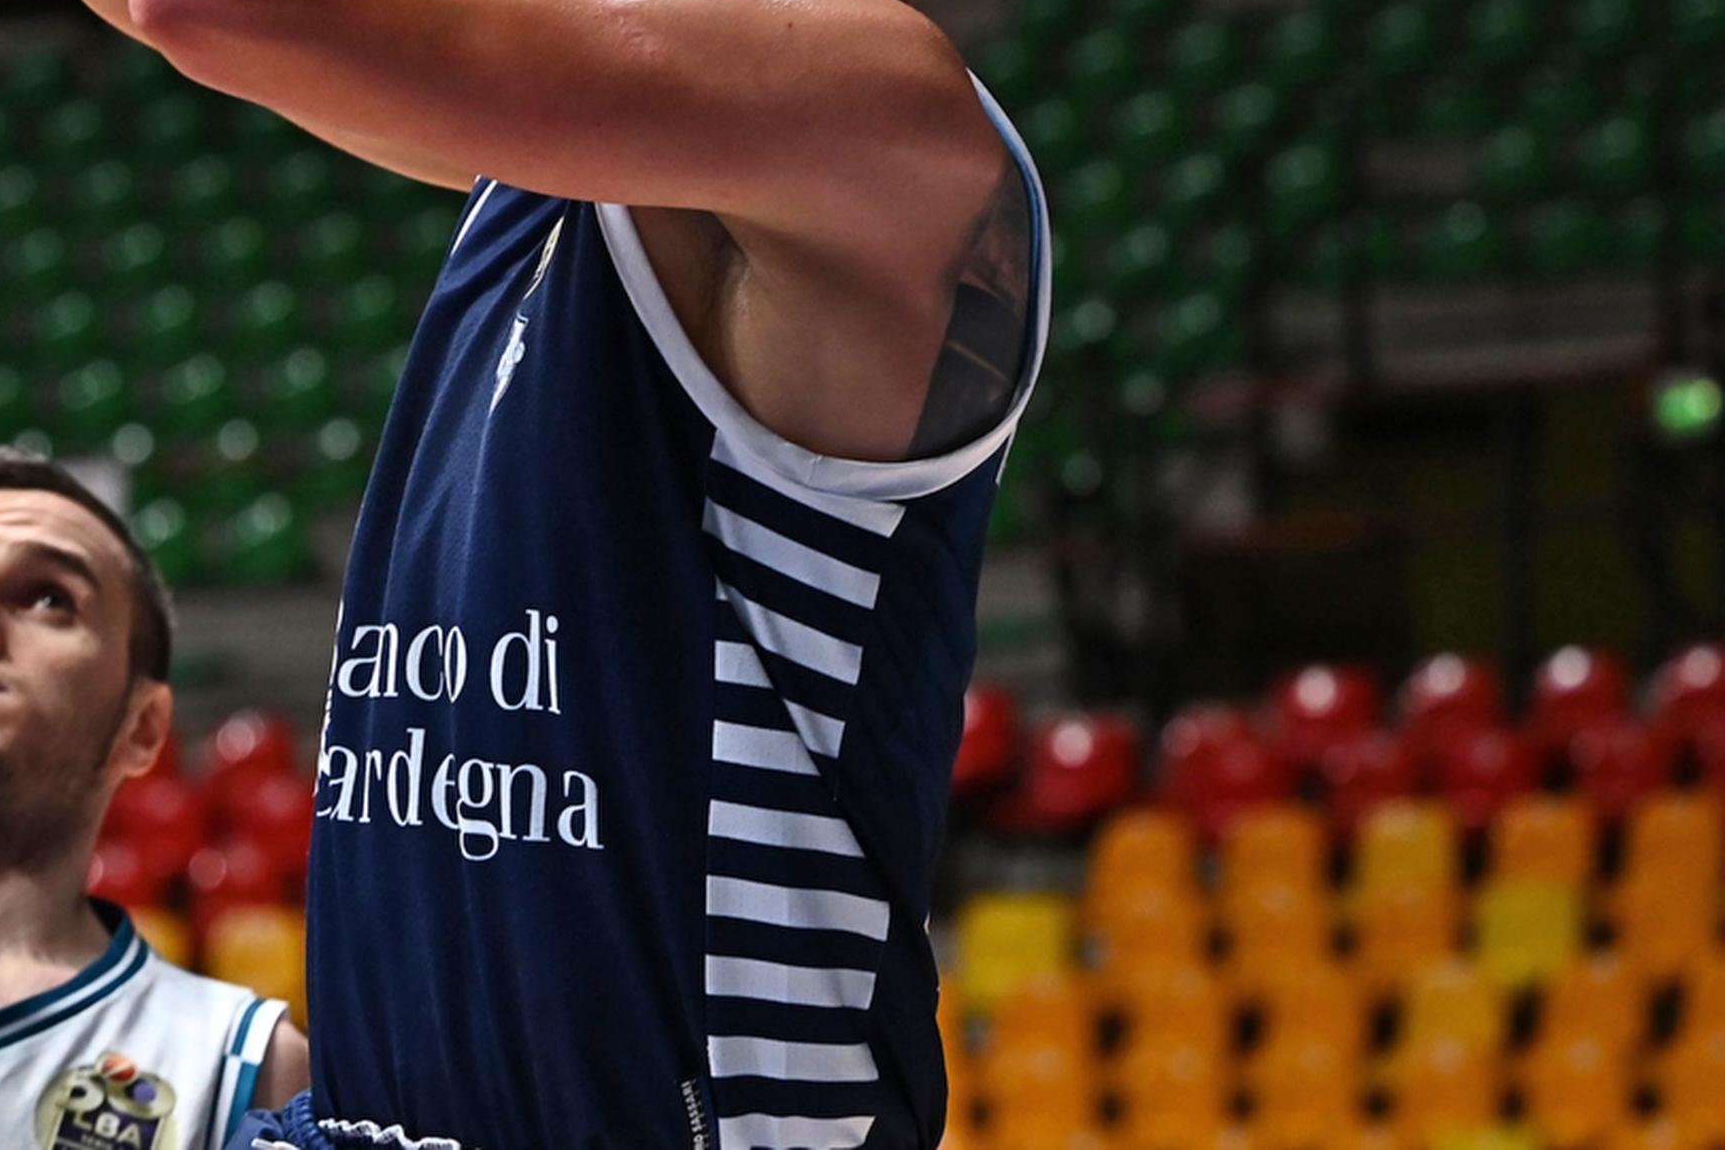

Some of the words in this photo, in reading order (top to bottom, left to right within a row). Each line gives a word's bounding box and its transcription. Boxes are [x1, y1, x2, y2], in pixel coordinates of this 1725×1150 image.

[329, 600, 467, 703] anco
[489, 608, 561, 714] di
[314, 712, 604, 861] ardegna
